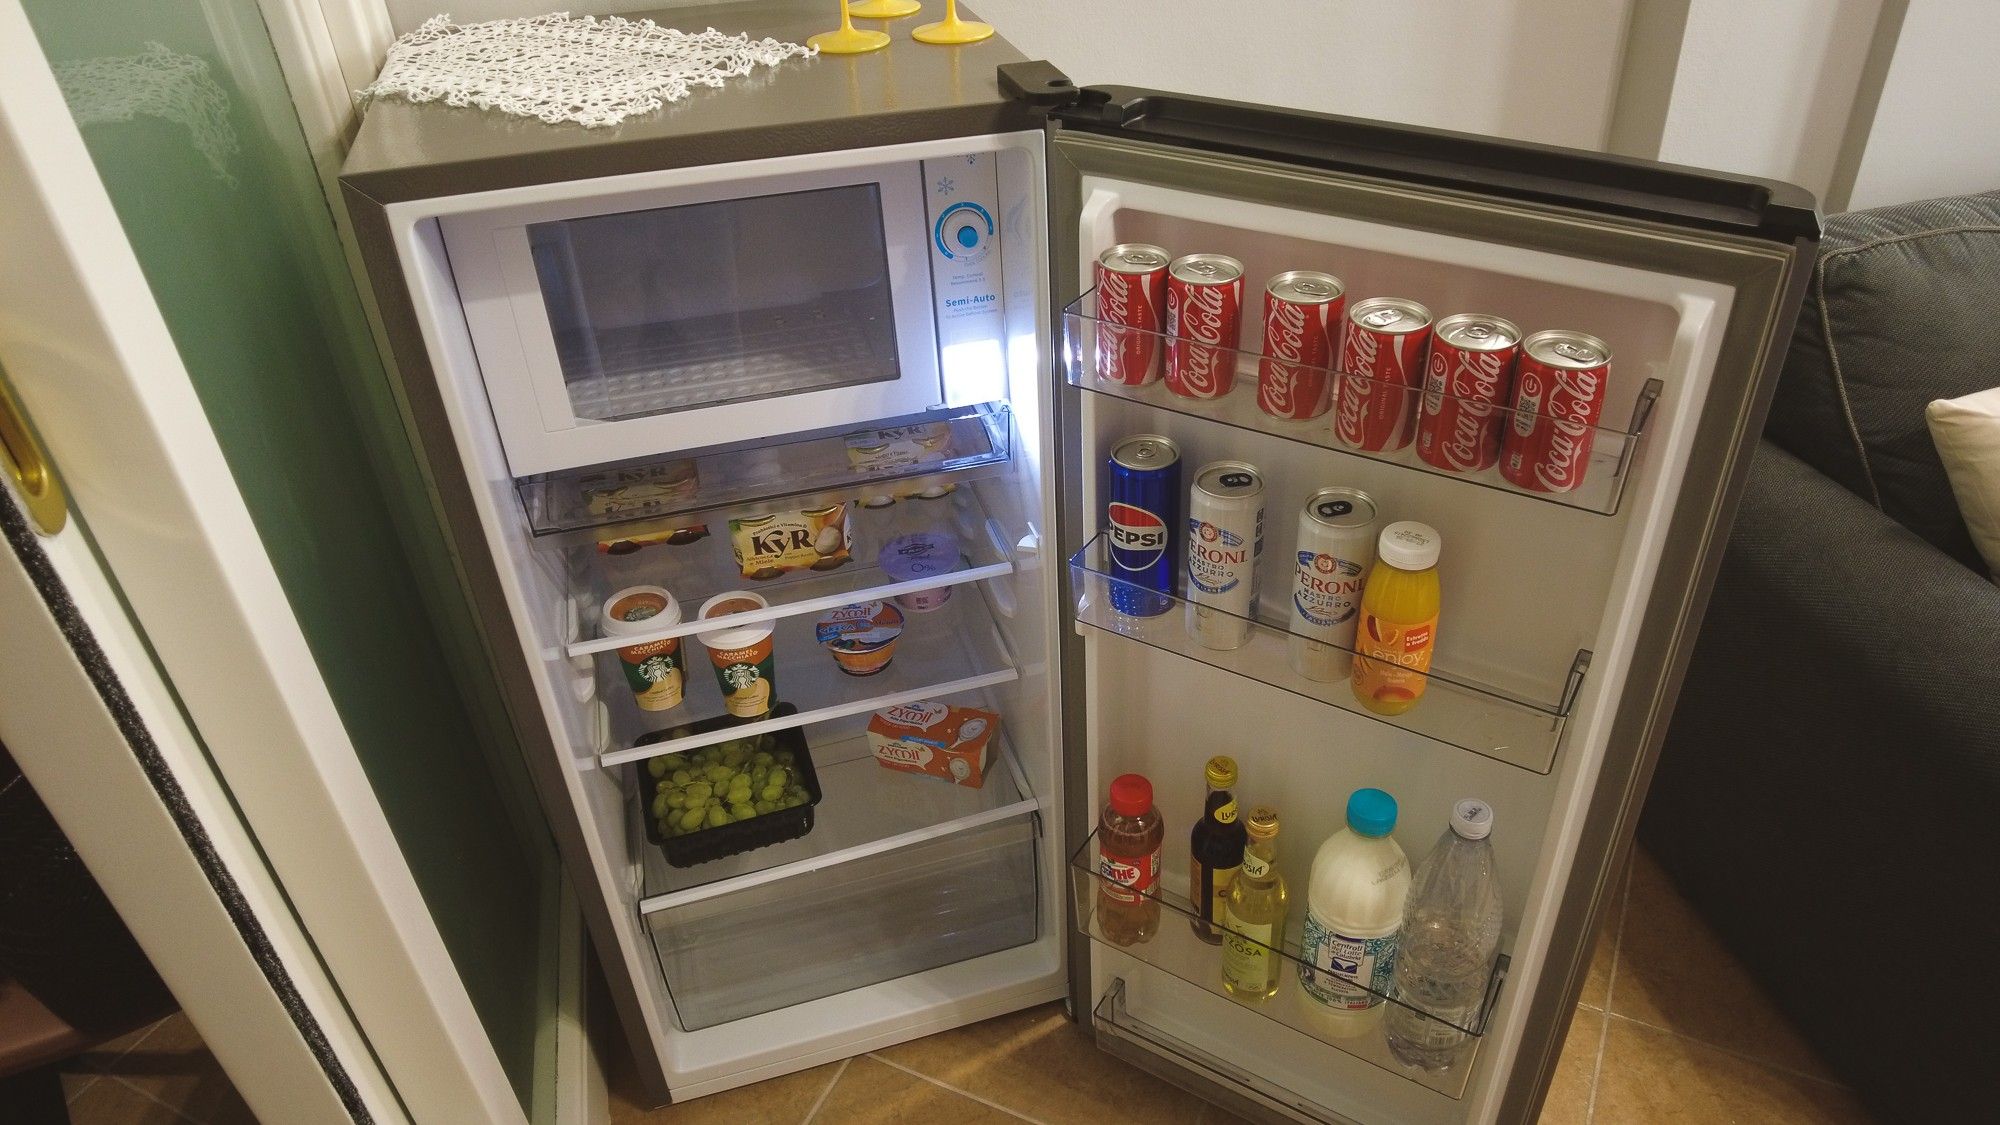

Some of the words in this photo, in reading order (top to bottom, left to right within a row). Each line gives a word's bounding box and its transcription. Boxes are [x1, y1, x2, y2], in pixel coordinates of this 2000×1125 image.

[945, 295, 996, 307] Semi-Auto
[1295, 561, 1364, 595] PERONI
[1298, 590, 1351, 608] AZZURRO
[1304, 588, 1342, 601] NASTRO
